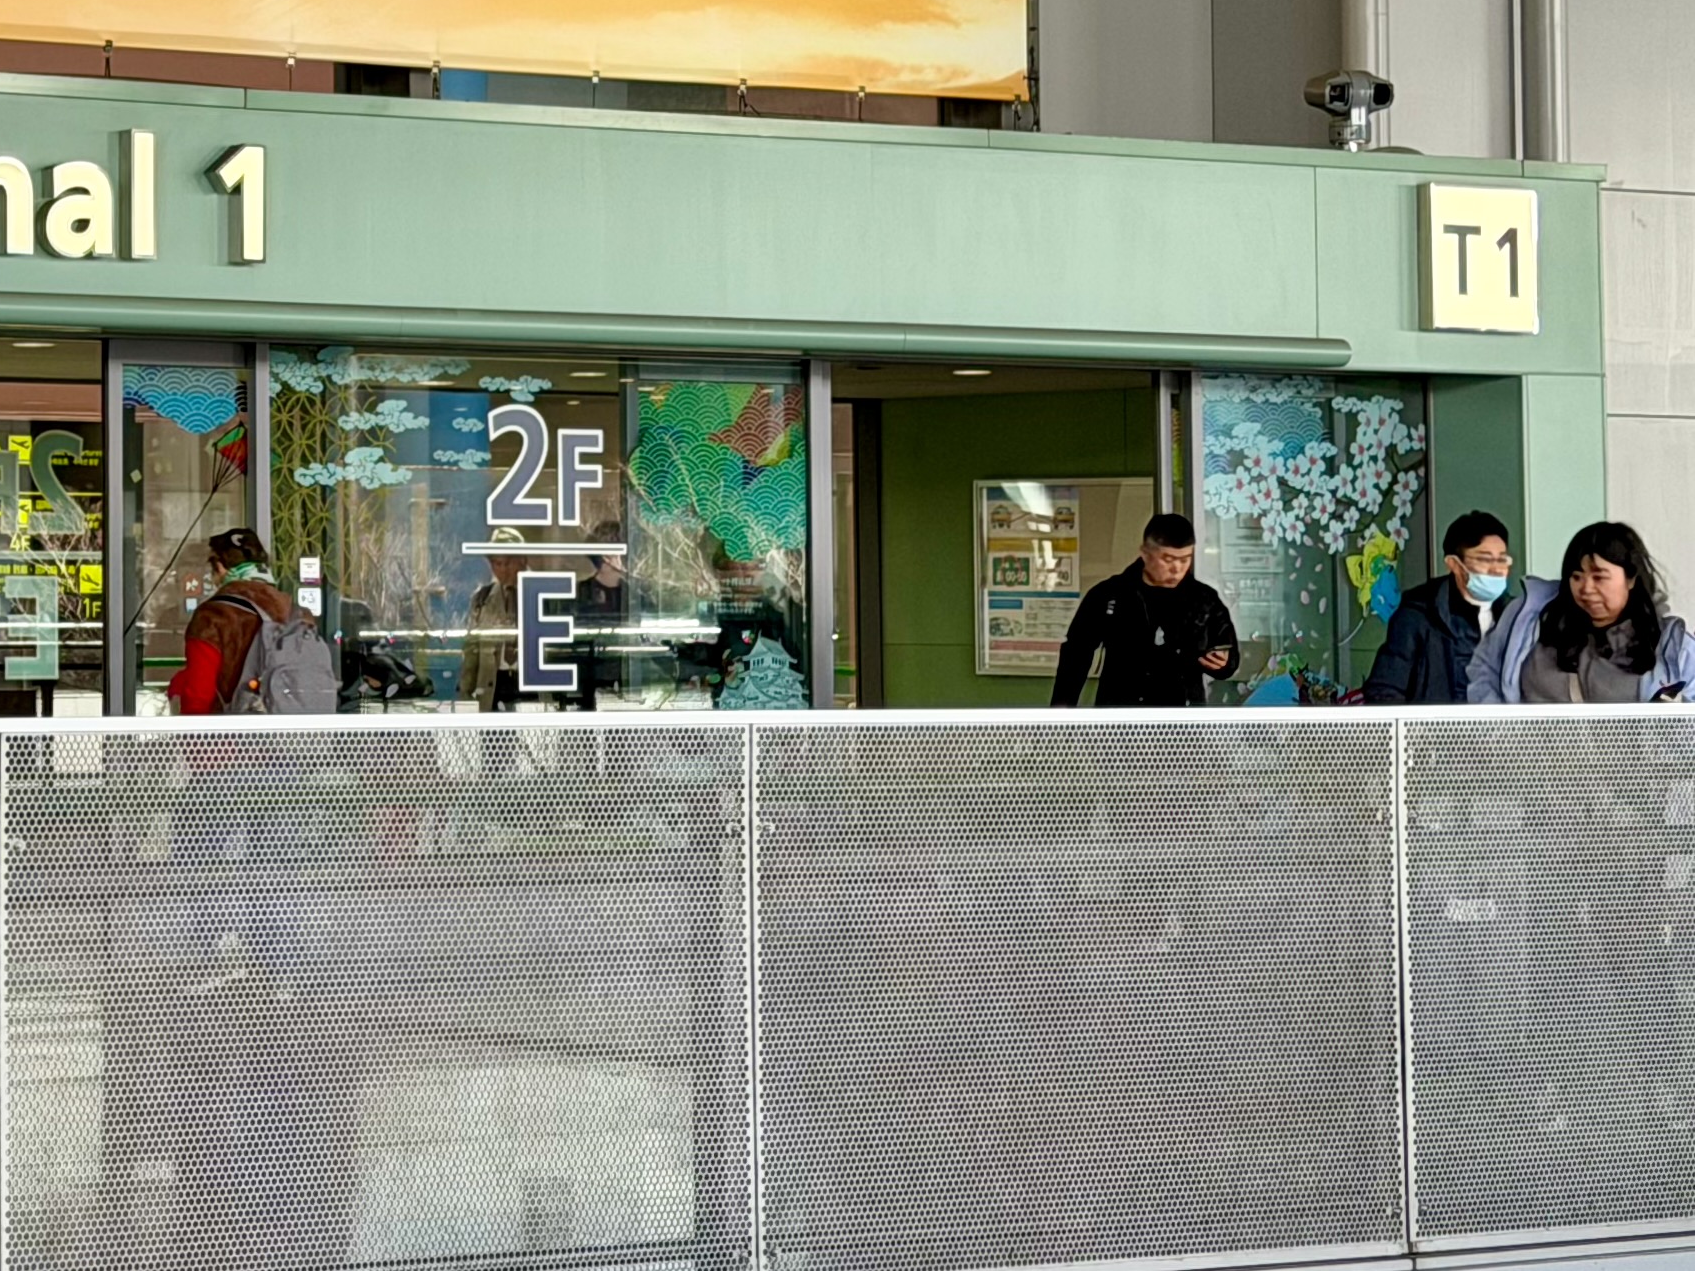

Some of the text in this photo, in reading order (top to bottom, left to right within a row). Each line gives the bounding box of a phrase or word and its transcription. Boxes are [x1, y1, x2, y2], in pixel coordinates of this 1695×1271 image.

[208, 142, 267, 264] 1
[1443, 223, 1519, 298] T1
[487, 403, 604, 527] 2F
[83, 597, 102, 619] 1F
[517, 570, 578, 692] E
